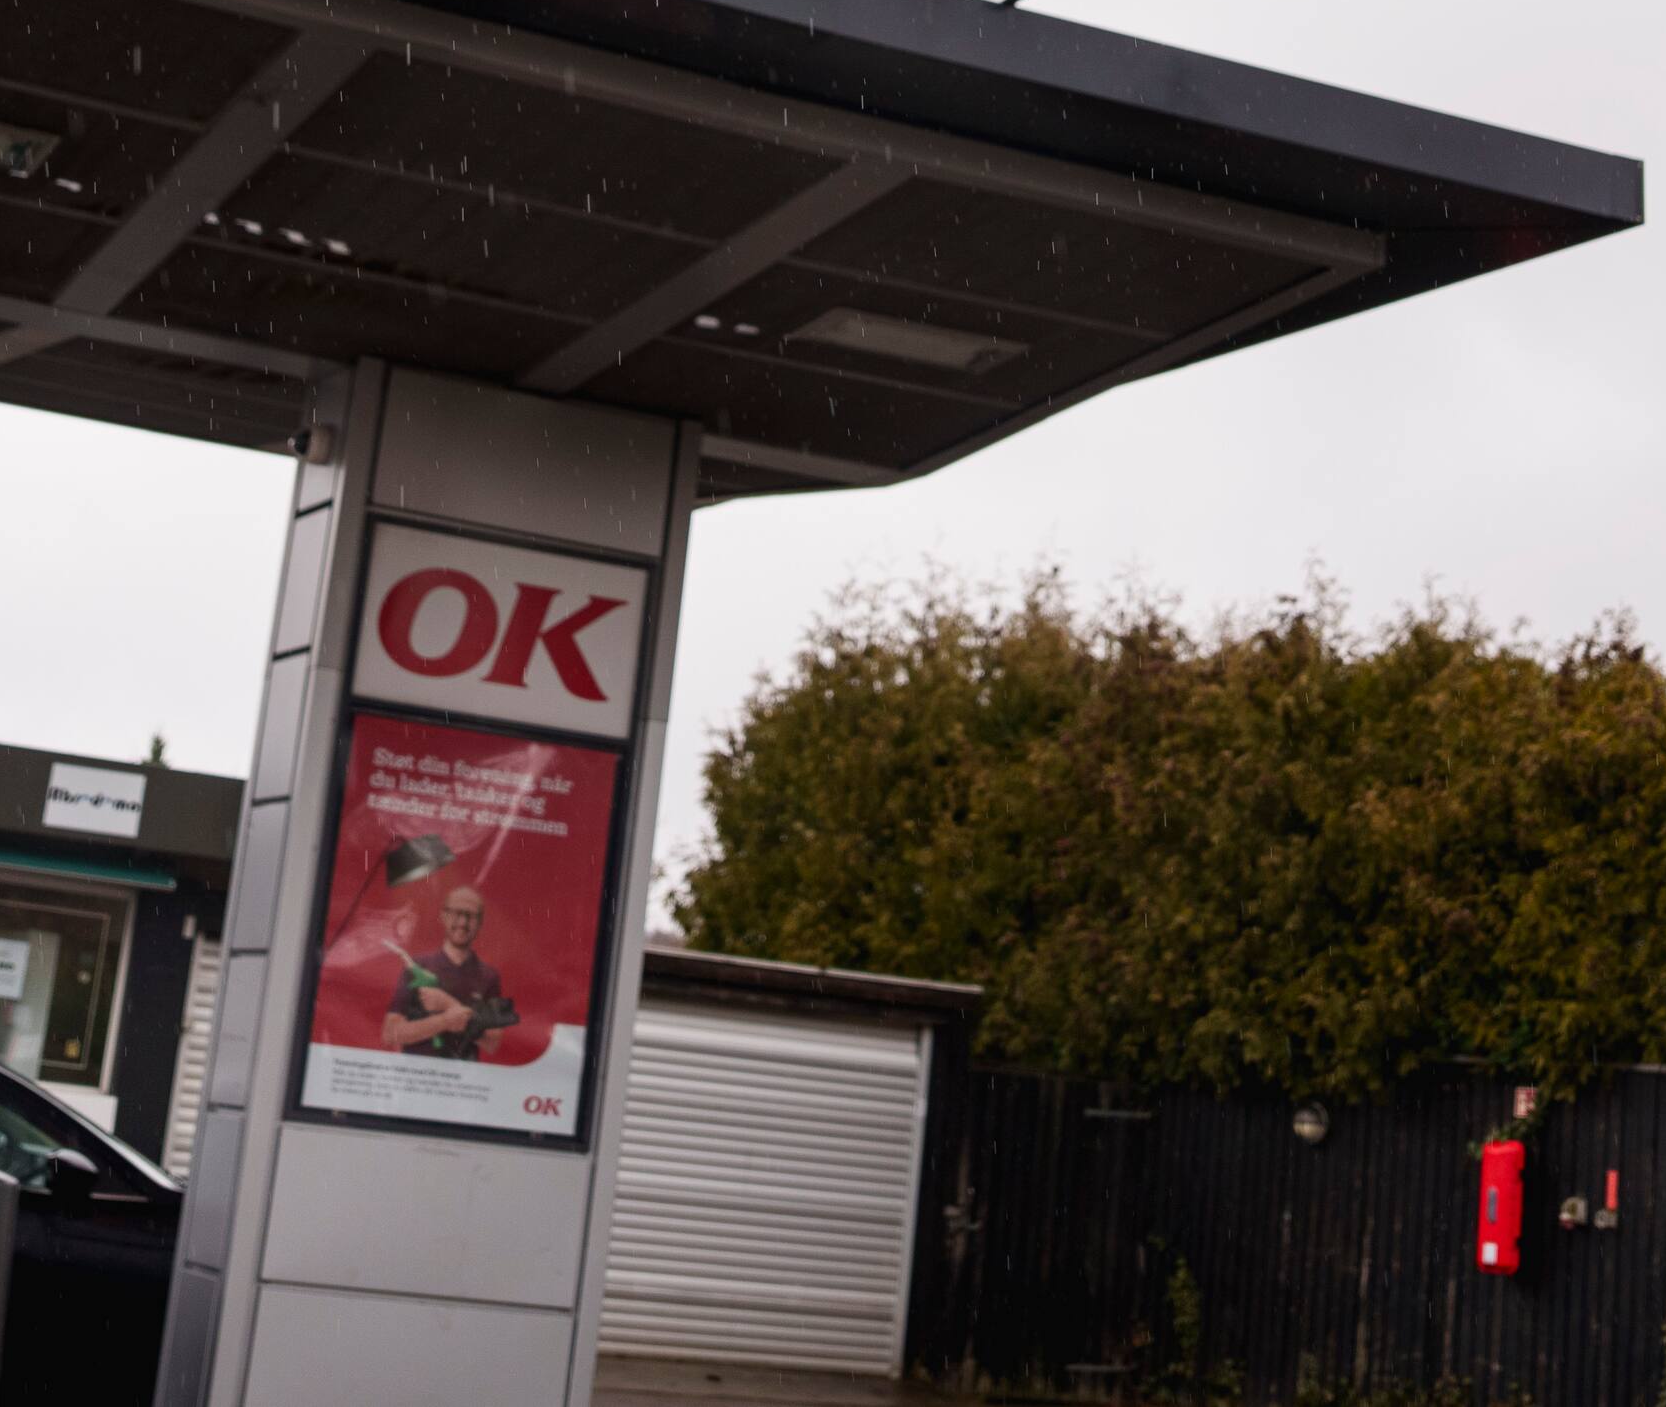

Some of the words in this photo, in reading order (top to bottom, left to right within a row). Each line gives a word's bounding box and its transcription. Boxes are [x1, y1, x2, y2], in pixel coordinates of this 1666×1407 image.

[377, 566, 630, 702] OK
[417, 754, 450, 776] din
[369, 769, 396, 790] du
[524, 795, 546, 815] og
[523, 1094, 563, 1117] OK
